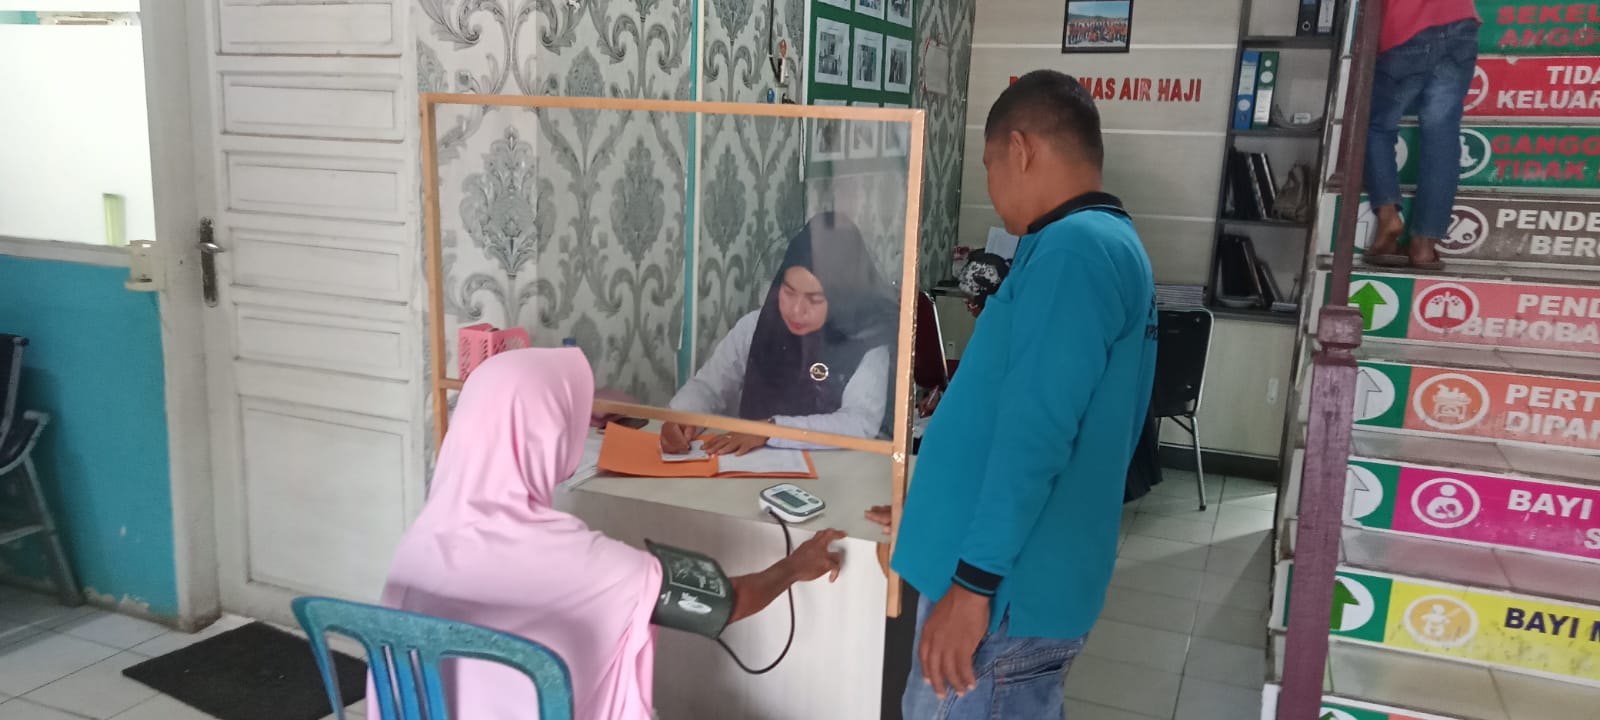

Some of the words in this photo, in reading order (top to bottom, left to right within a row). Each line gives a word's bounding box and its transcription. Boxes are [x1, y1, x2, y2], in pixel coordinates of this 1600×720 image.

[1498, 27, 1600, 48] ANGG
[1119, 77, 1152, 101] AIR
[1158, 79, 1202, 102] HAJI
[1494, 160, 1585, 180] TIDAK
[1529, 235, 1600, 258] BER
[1507, 488, 1593, 520] BAYI
[1504, 607, 1580, 639] BAYI
